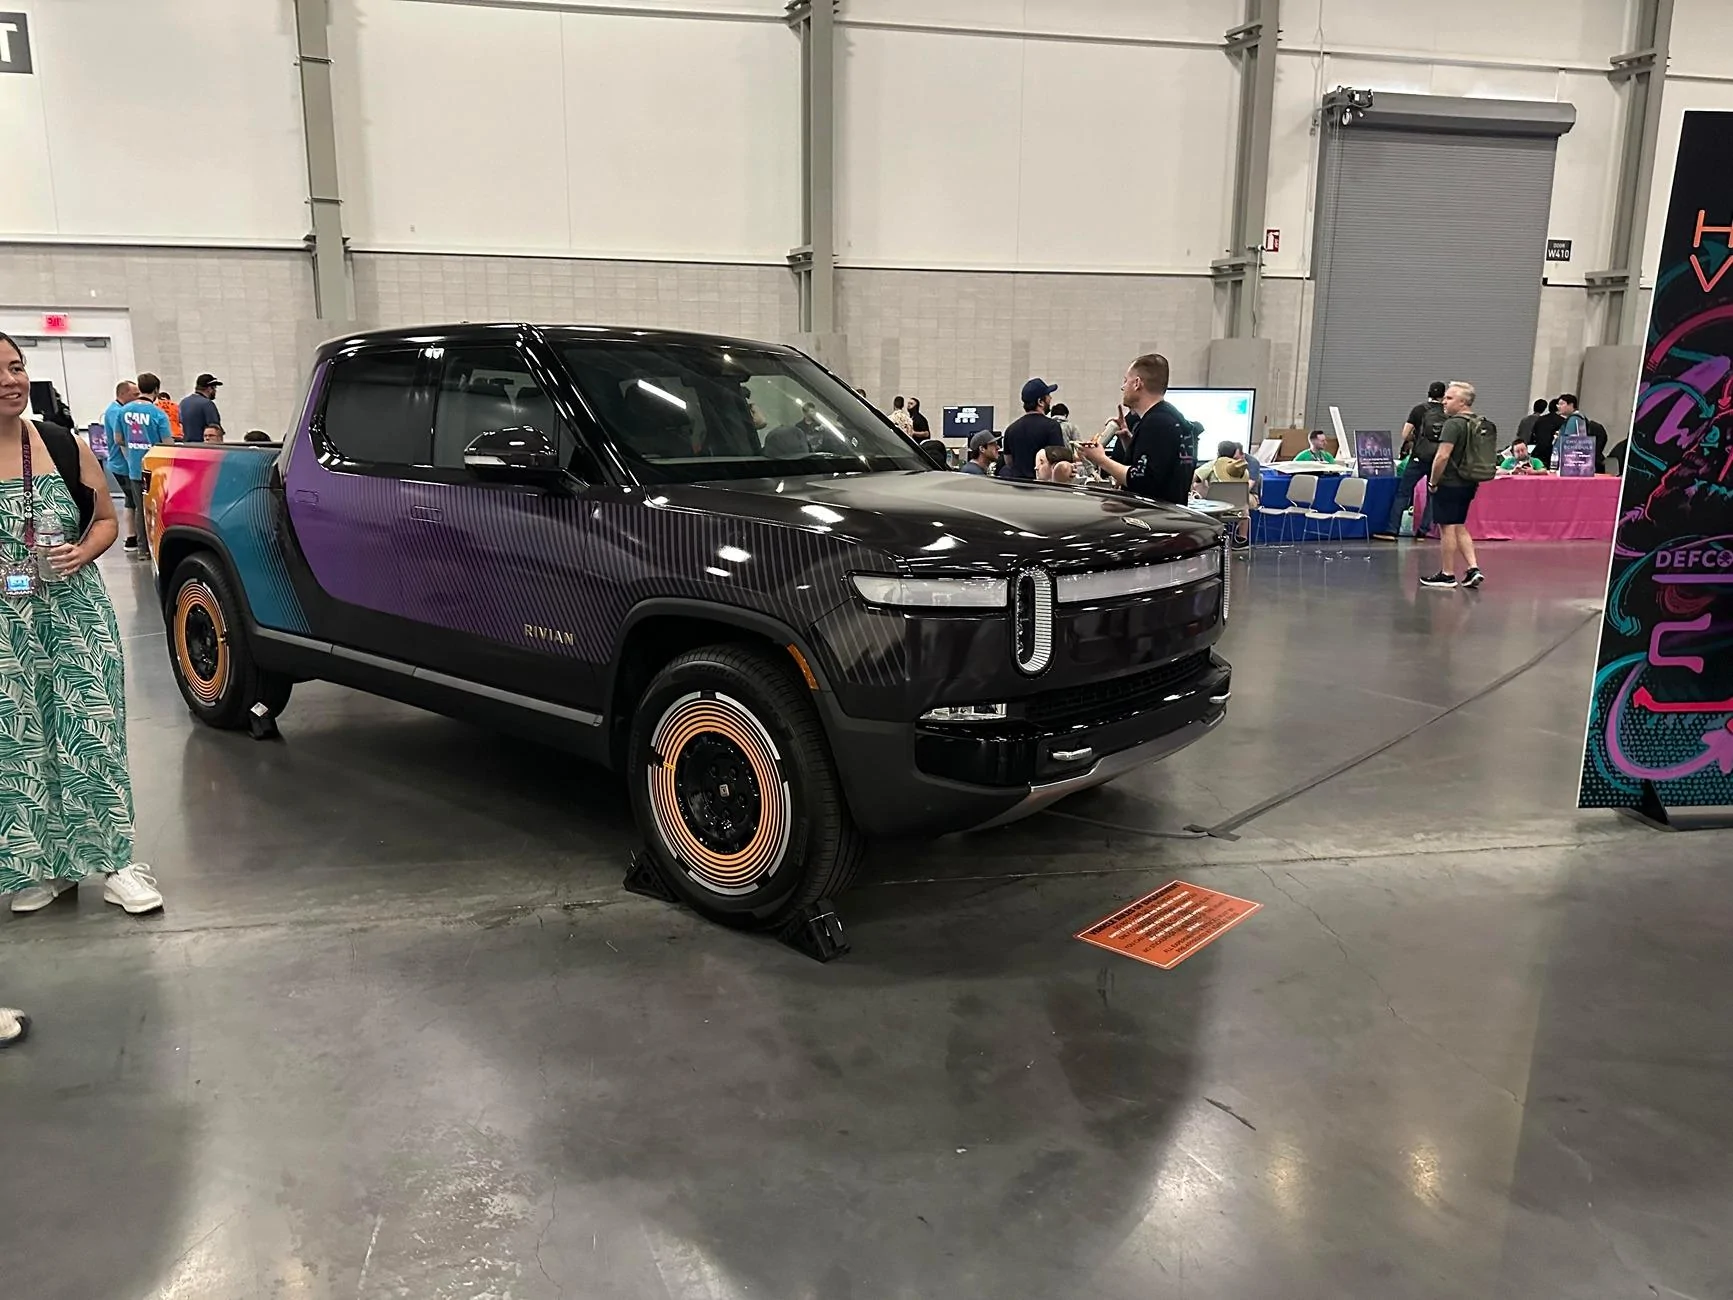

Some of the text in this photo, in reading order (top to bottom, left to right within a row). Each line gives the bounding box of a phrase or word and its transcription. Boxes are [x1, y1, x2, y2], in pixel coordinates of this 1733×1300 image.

[1548, 249, 1570, 258] W410
[124, 412, 150, 426] CAN
[524, 623, 574, 646] RIVIAN
